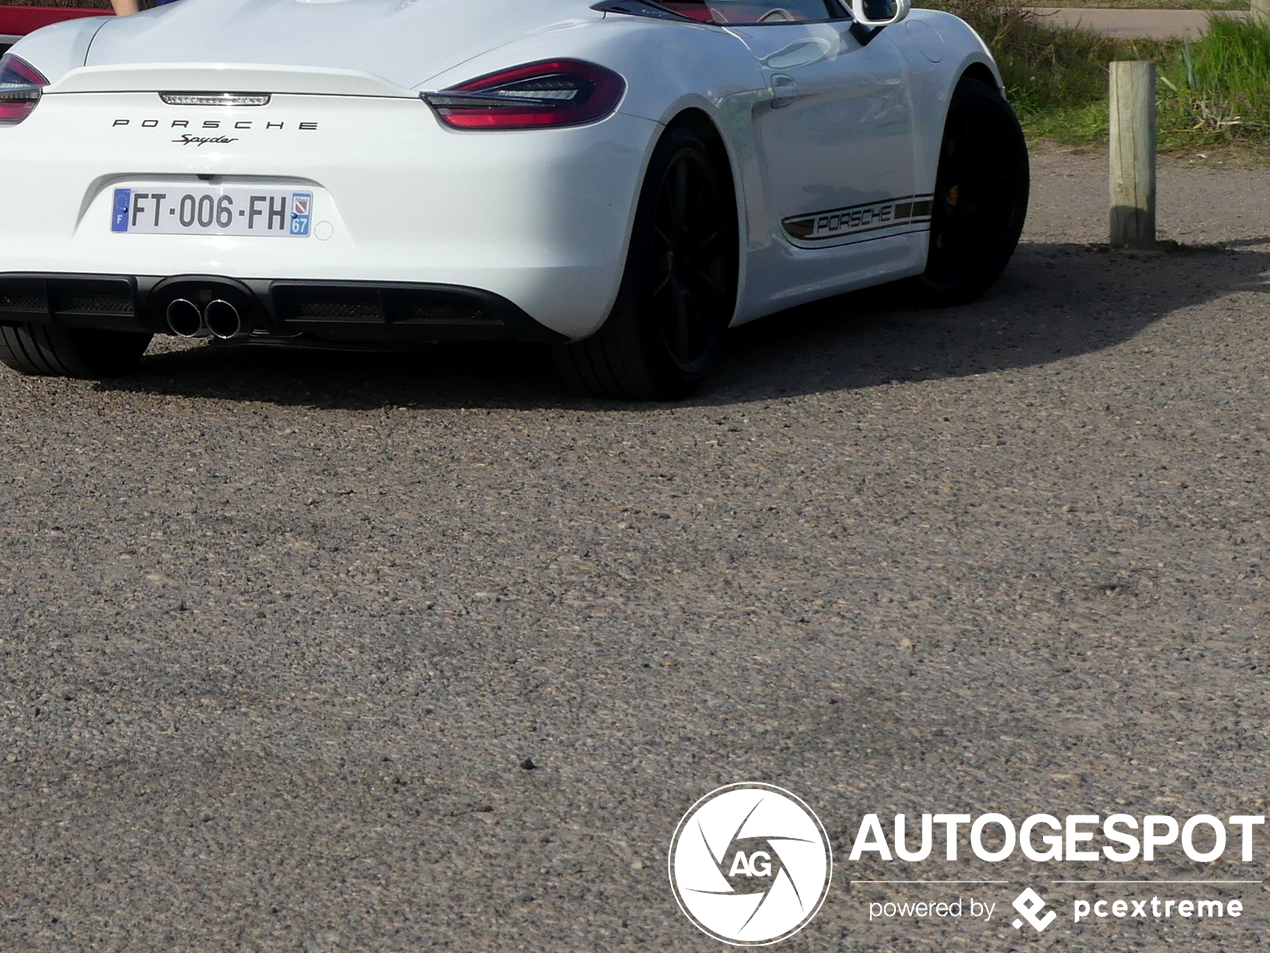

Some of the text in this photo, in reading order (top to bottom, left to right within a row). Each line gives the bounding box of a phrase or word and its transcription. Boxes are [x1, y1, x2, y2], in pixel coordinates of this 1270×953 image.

[112, 119, 319, 131] PORSCHE
[171, 133, 239, 147] Spyder
[131, 193, 287, 230] FT-006-FH
[116, 214, 123, 224] F
[292, 218, 308, 233] 67
[817, 204, 892, 234] PORSCHE
